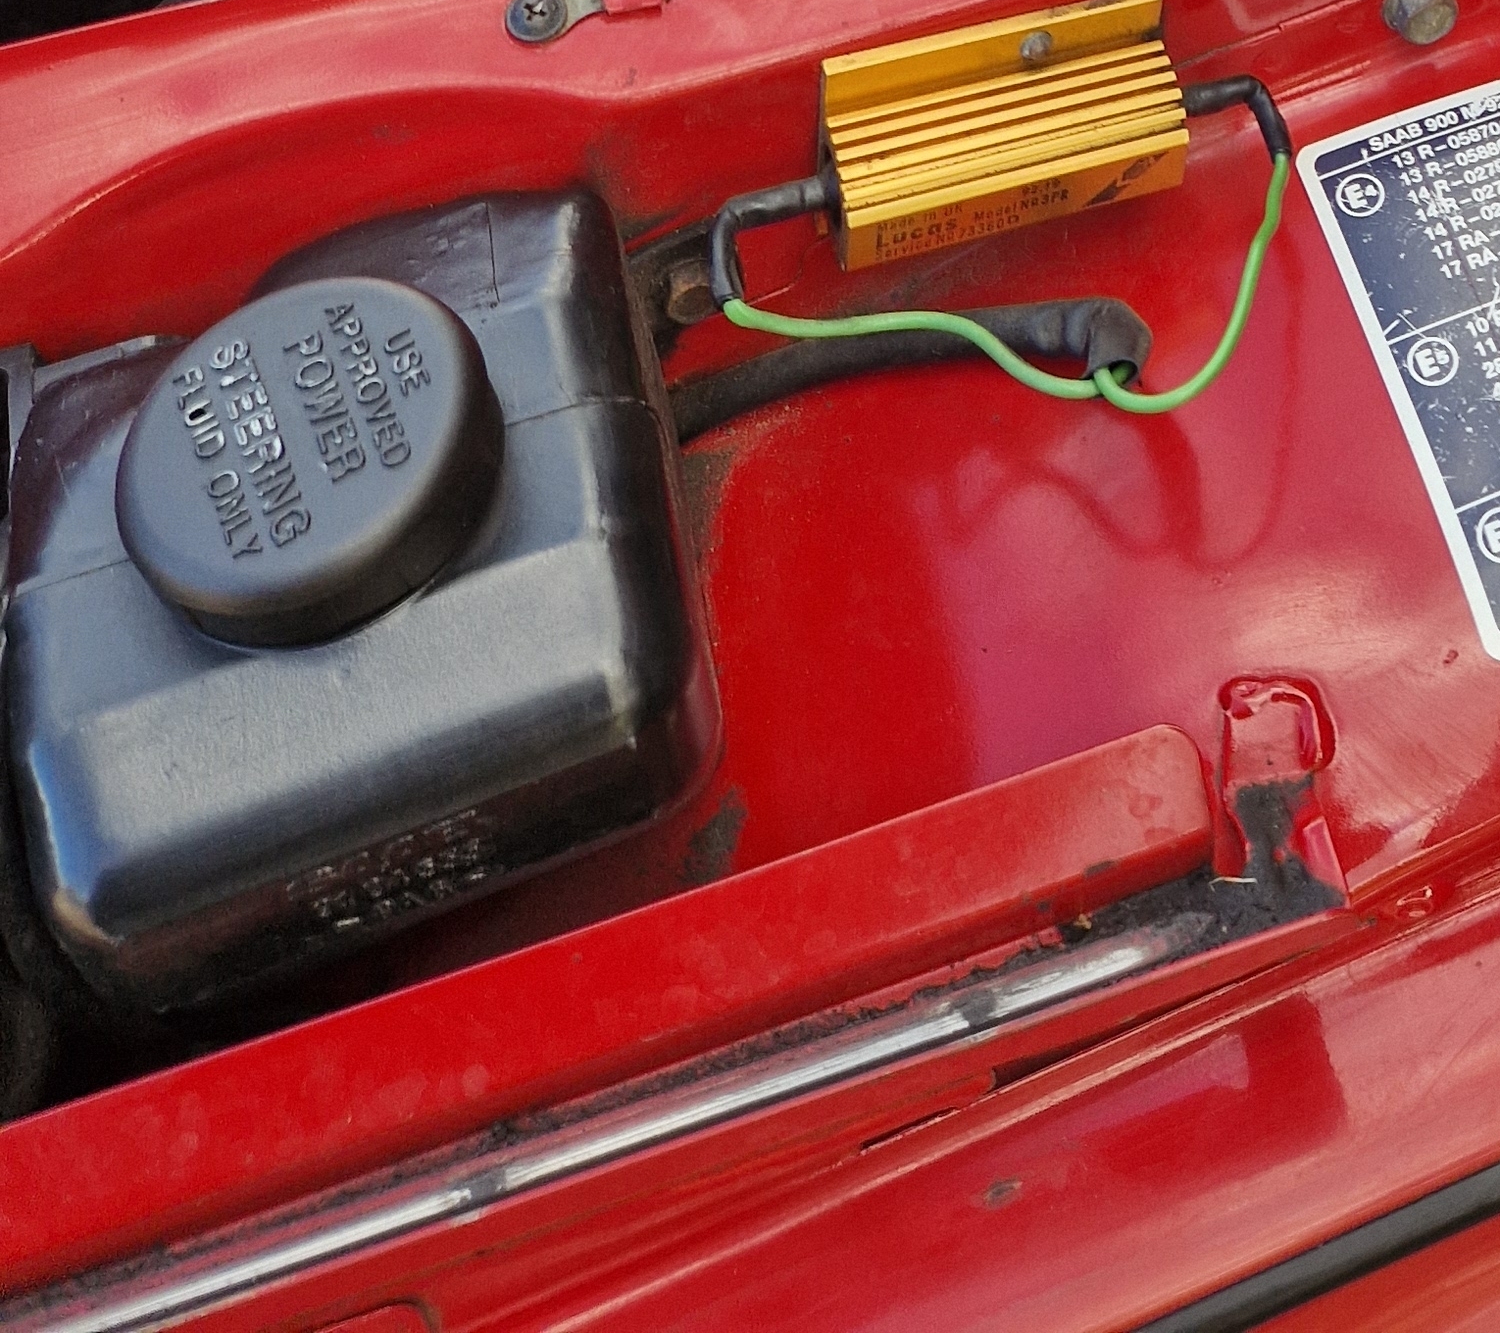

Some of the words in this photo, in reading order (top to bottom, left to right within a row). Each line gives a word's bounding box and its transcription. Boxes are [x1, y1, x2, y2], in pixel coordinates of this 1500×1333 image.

[1366, 121, 1426, 153] SAAB
[1421, 109, 1461, 135] 900
[1389, 147, 1417, 169] 13
[1397, 168, 1418, 188] 13
[875, 218, 958, 250] Lucas
[1421, 220, 1449, 242] 14
[1430, 239, 1457, 261] 17
[1438, 258, 1464, 280] 17
[1464, 315, 1491, 339] 10
[1472, 336, 1498, 359] 11
[384, 327, 432, 398] USE
[323, 303, 412, 468] APPROVED
[283, 330, 367, 484] POWER
[210, 338, 312, 548] STEERING
[172, 366, 226, 459] FLUID
[206, 469, 264, 560] ONLY
